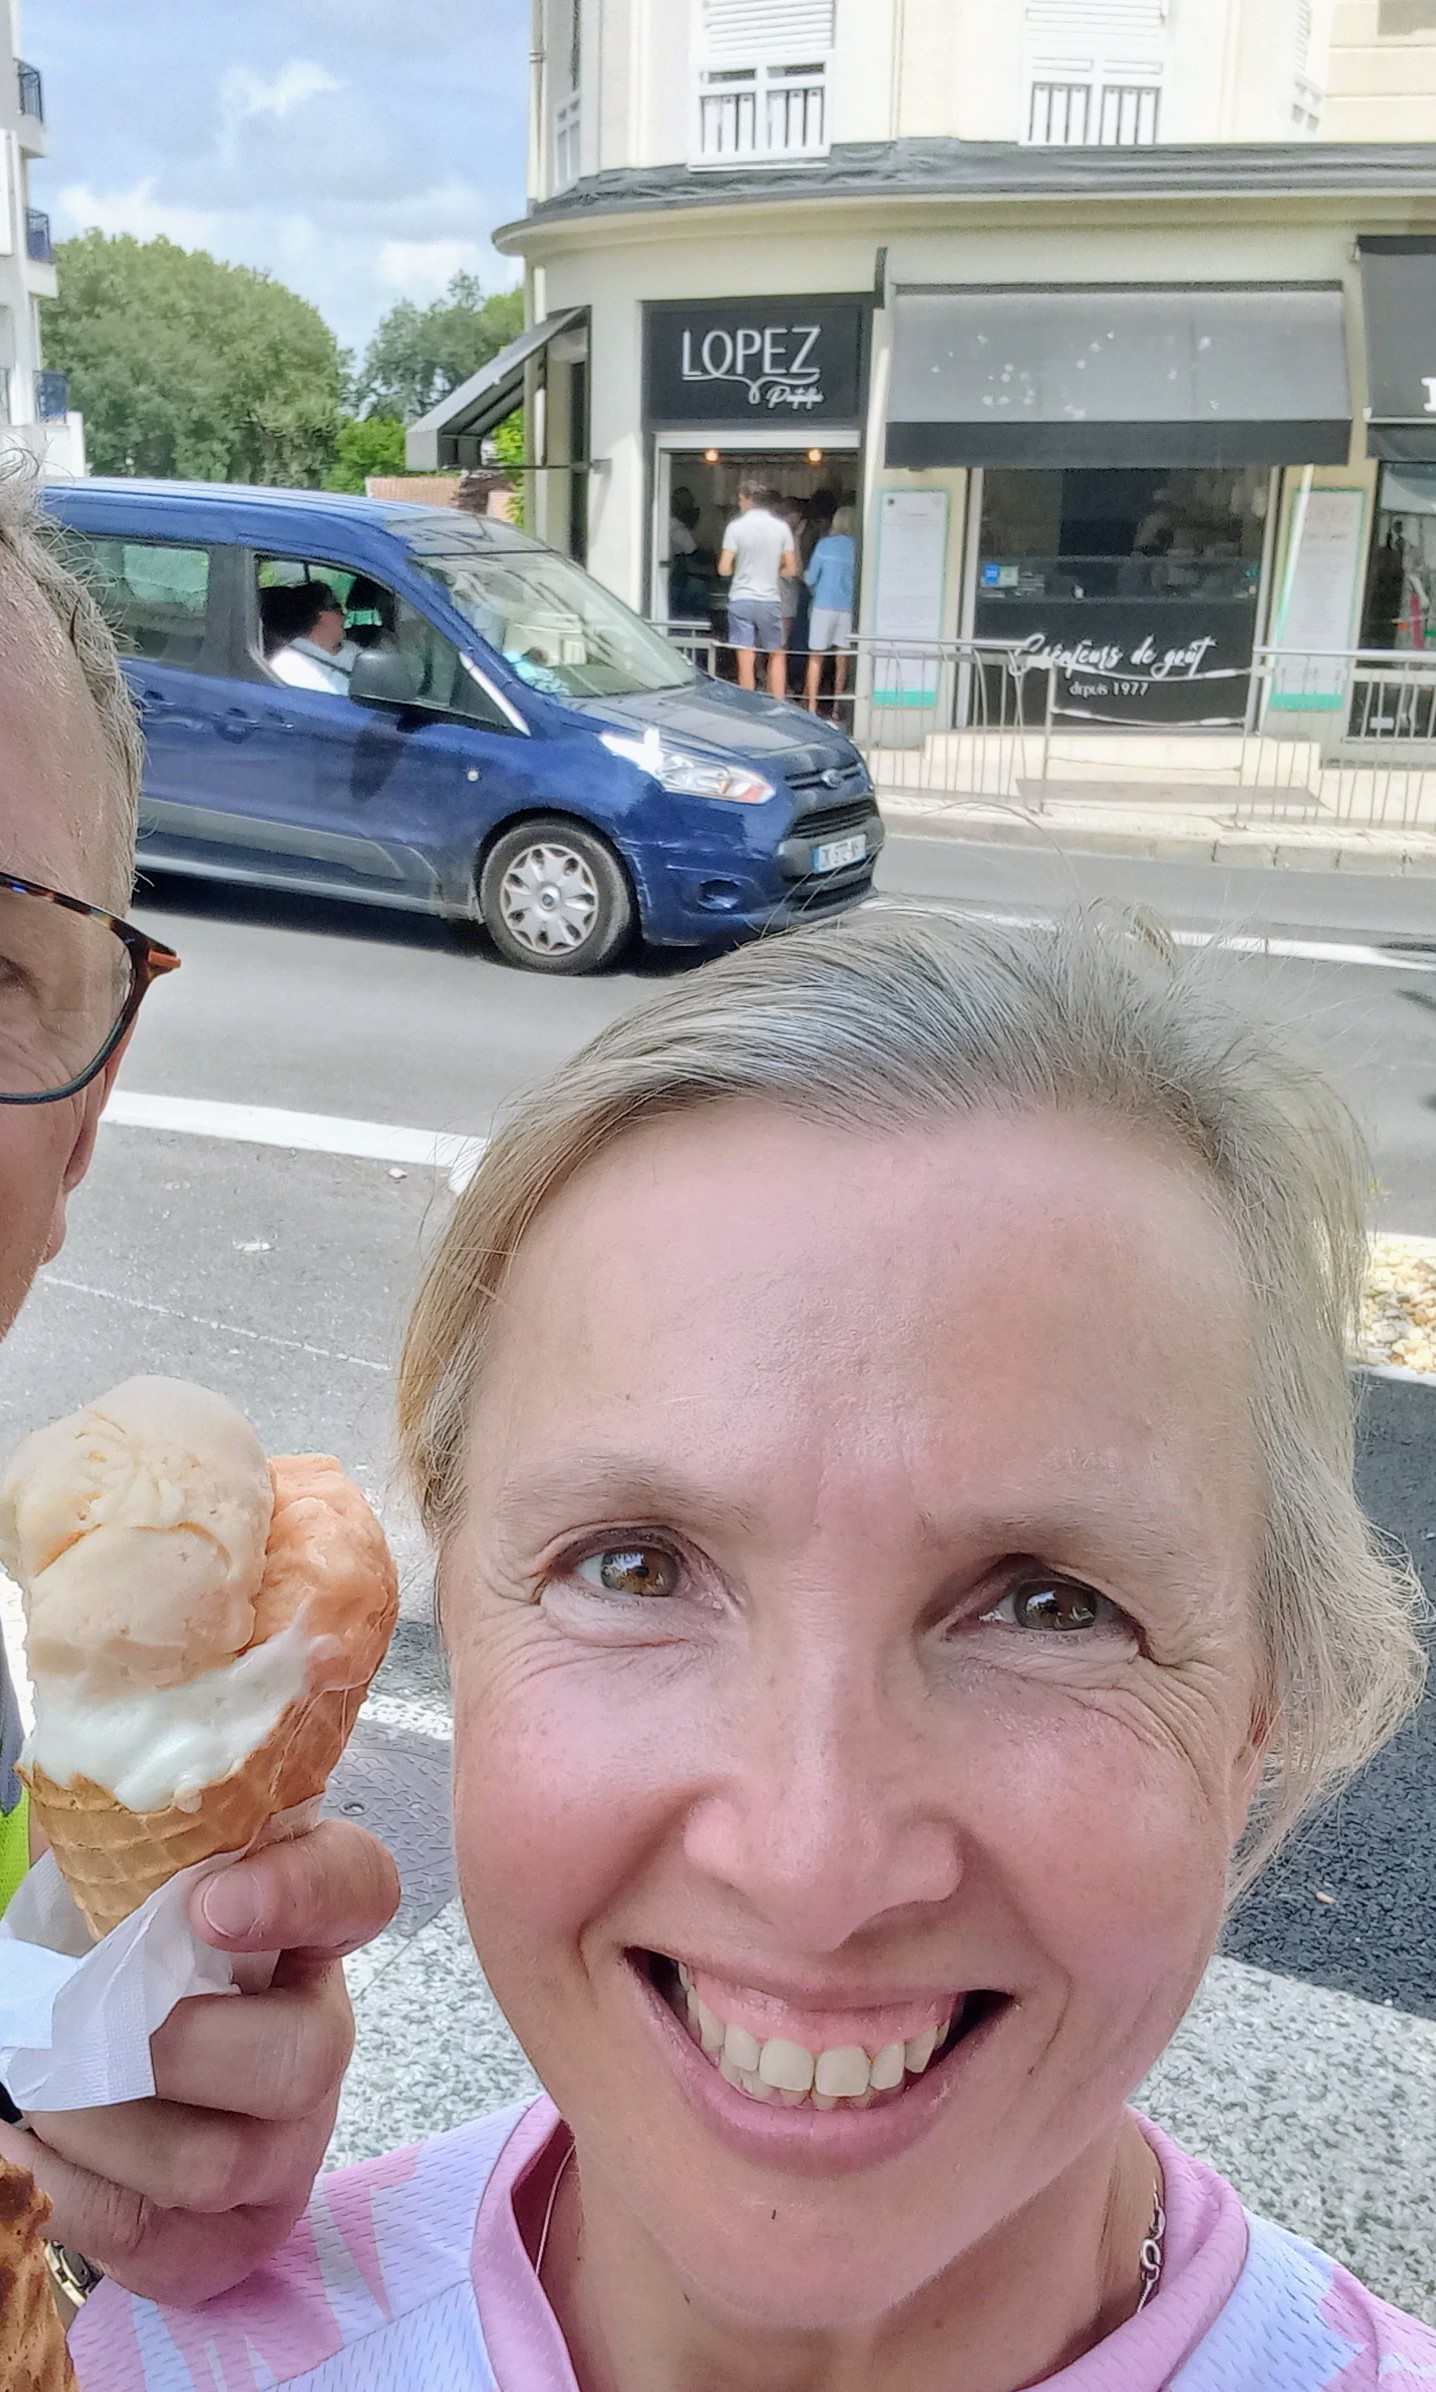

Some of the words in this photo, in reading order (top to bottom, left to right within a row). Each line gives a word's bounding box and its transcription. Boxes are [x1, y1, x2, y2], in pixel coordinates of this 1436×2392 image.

[682, 325, 821, 379] LOPEZ
[1130, 634, 1156, 665] de
[1069, 681, 1109, 698] depuis
[1113, 681, 1149, 696] 1977
